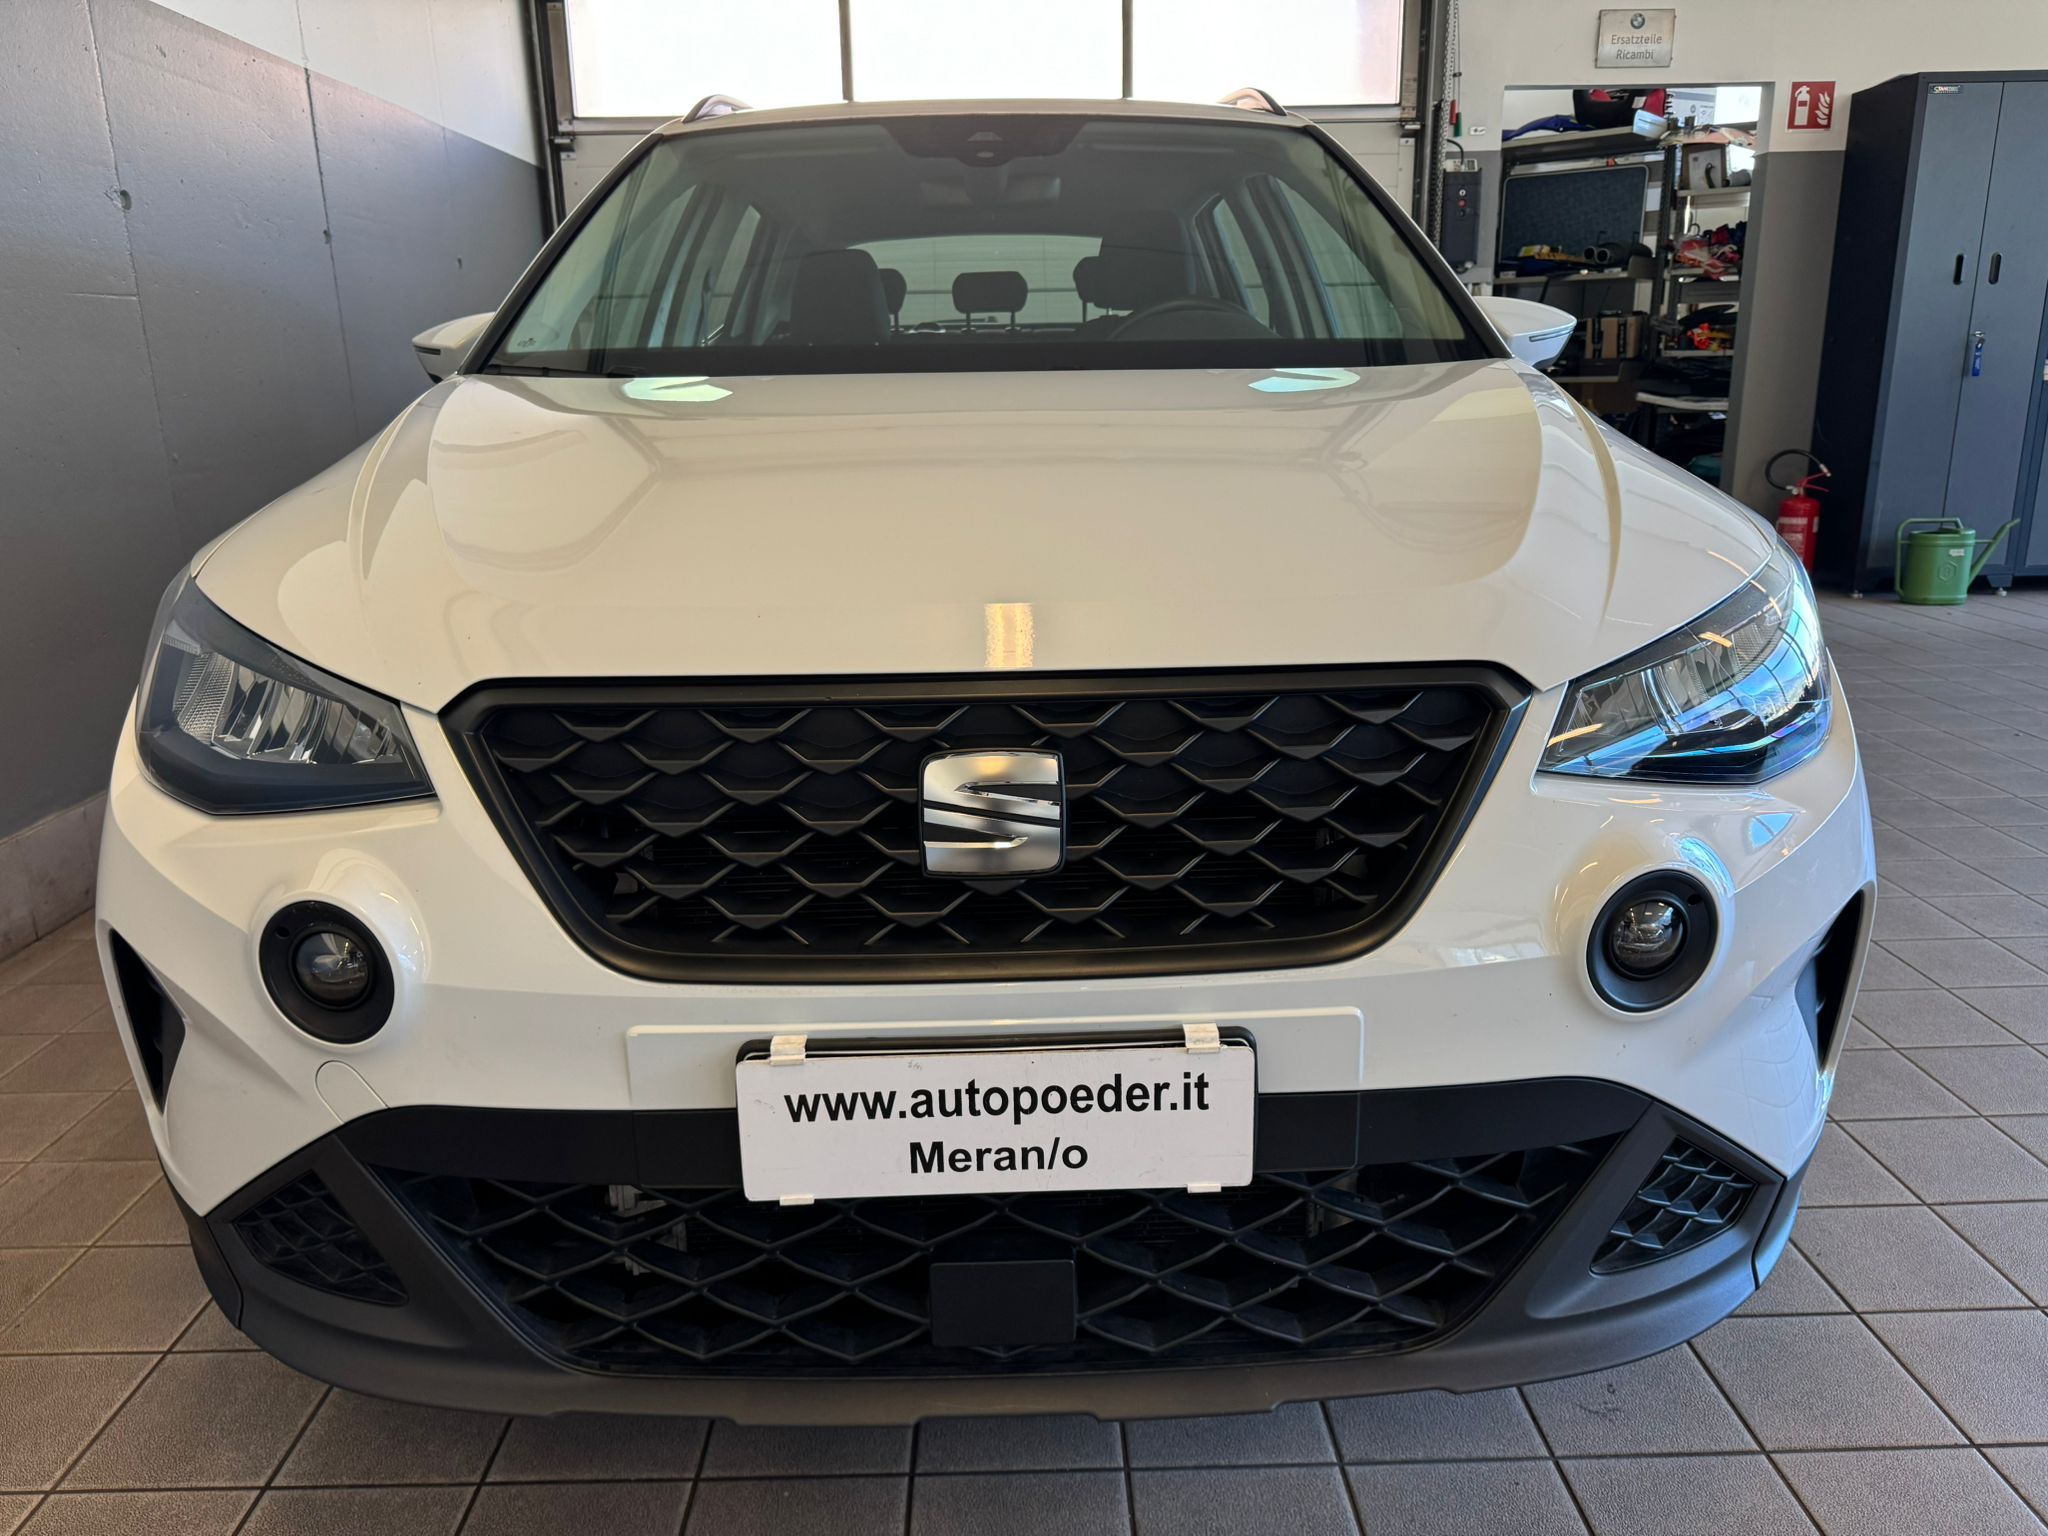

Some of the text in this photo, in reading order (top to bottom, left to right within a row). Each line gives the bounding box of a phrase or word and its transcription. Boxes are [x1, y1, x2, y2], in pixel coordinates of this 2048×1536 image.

[1611, 34, 1662, 45] Ersatzteile
[1615, 49, 1654, 60] Ricambi
[784, 1072, 1210, 1126] www.autopoeder.it
[909, 1137, 1089, 1174] Meran/o
